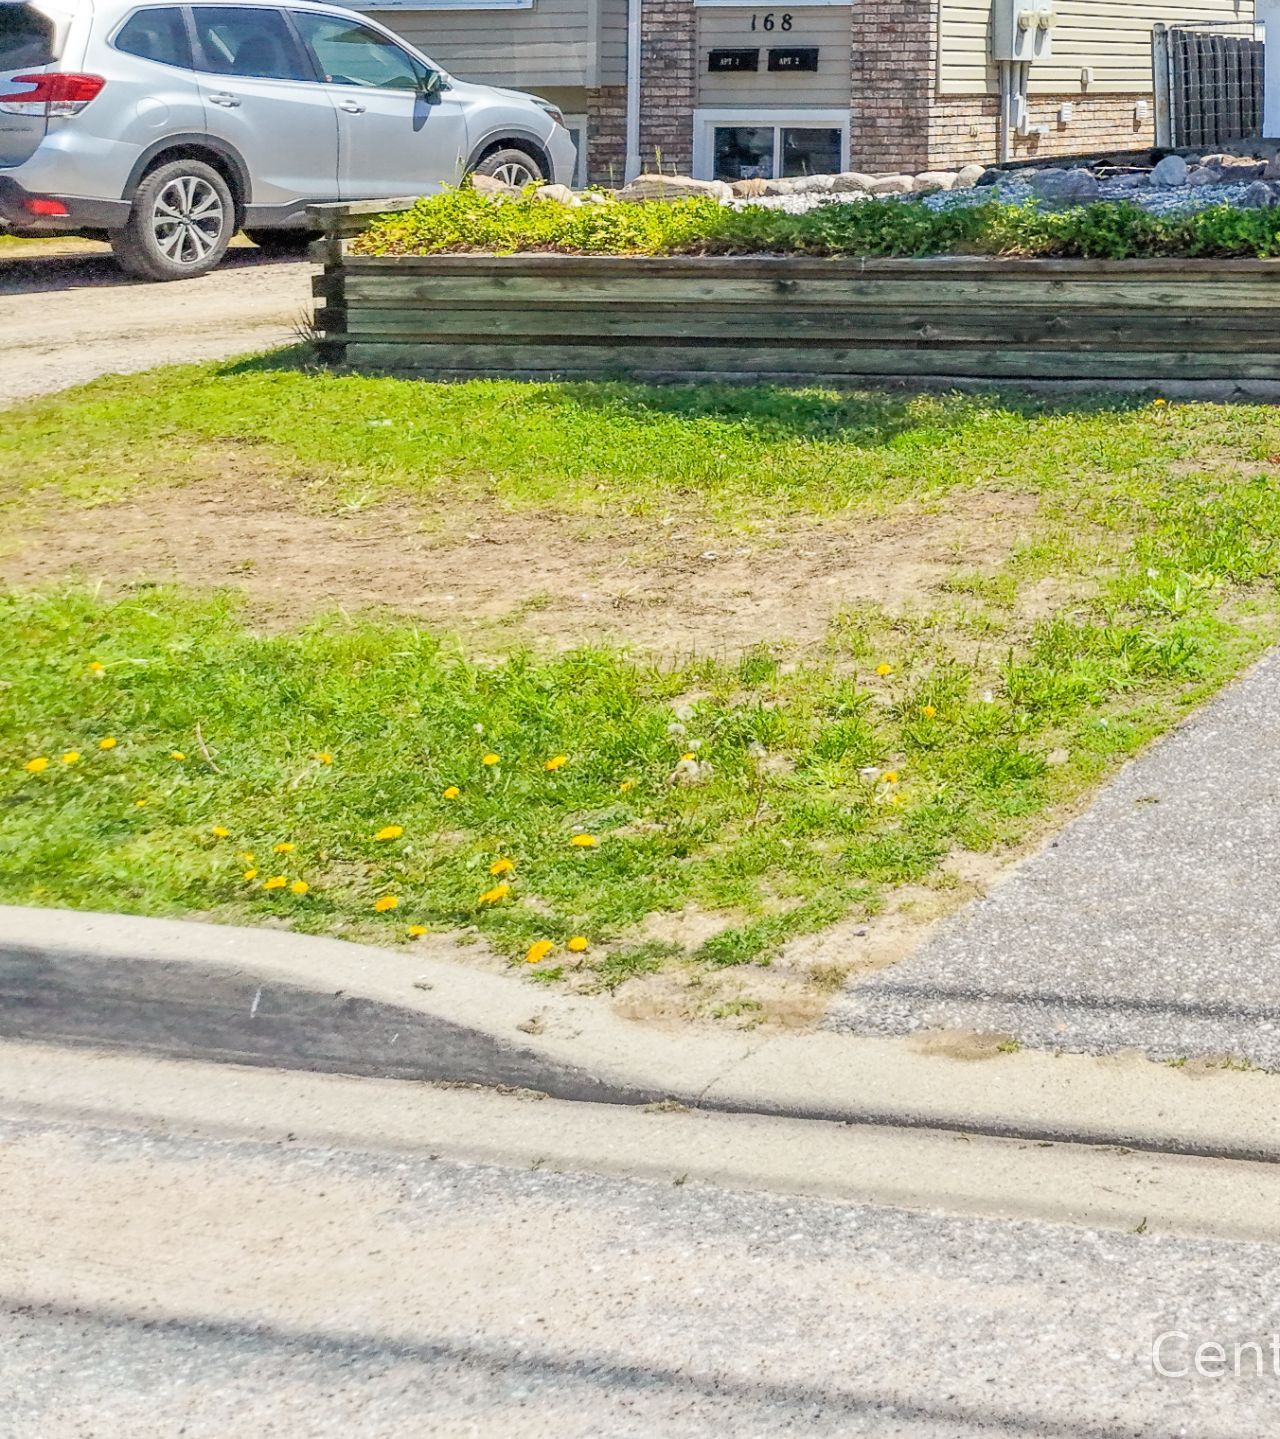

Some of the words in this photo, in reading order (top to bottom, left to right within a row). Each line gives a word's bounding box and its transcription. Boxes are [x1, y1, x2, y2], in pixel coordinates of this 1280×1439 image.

[751, 13, 793, 31] 168
[720, 57, 733, 66] APT
[778, 56, 792, 65] APT
